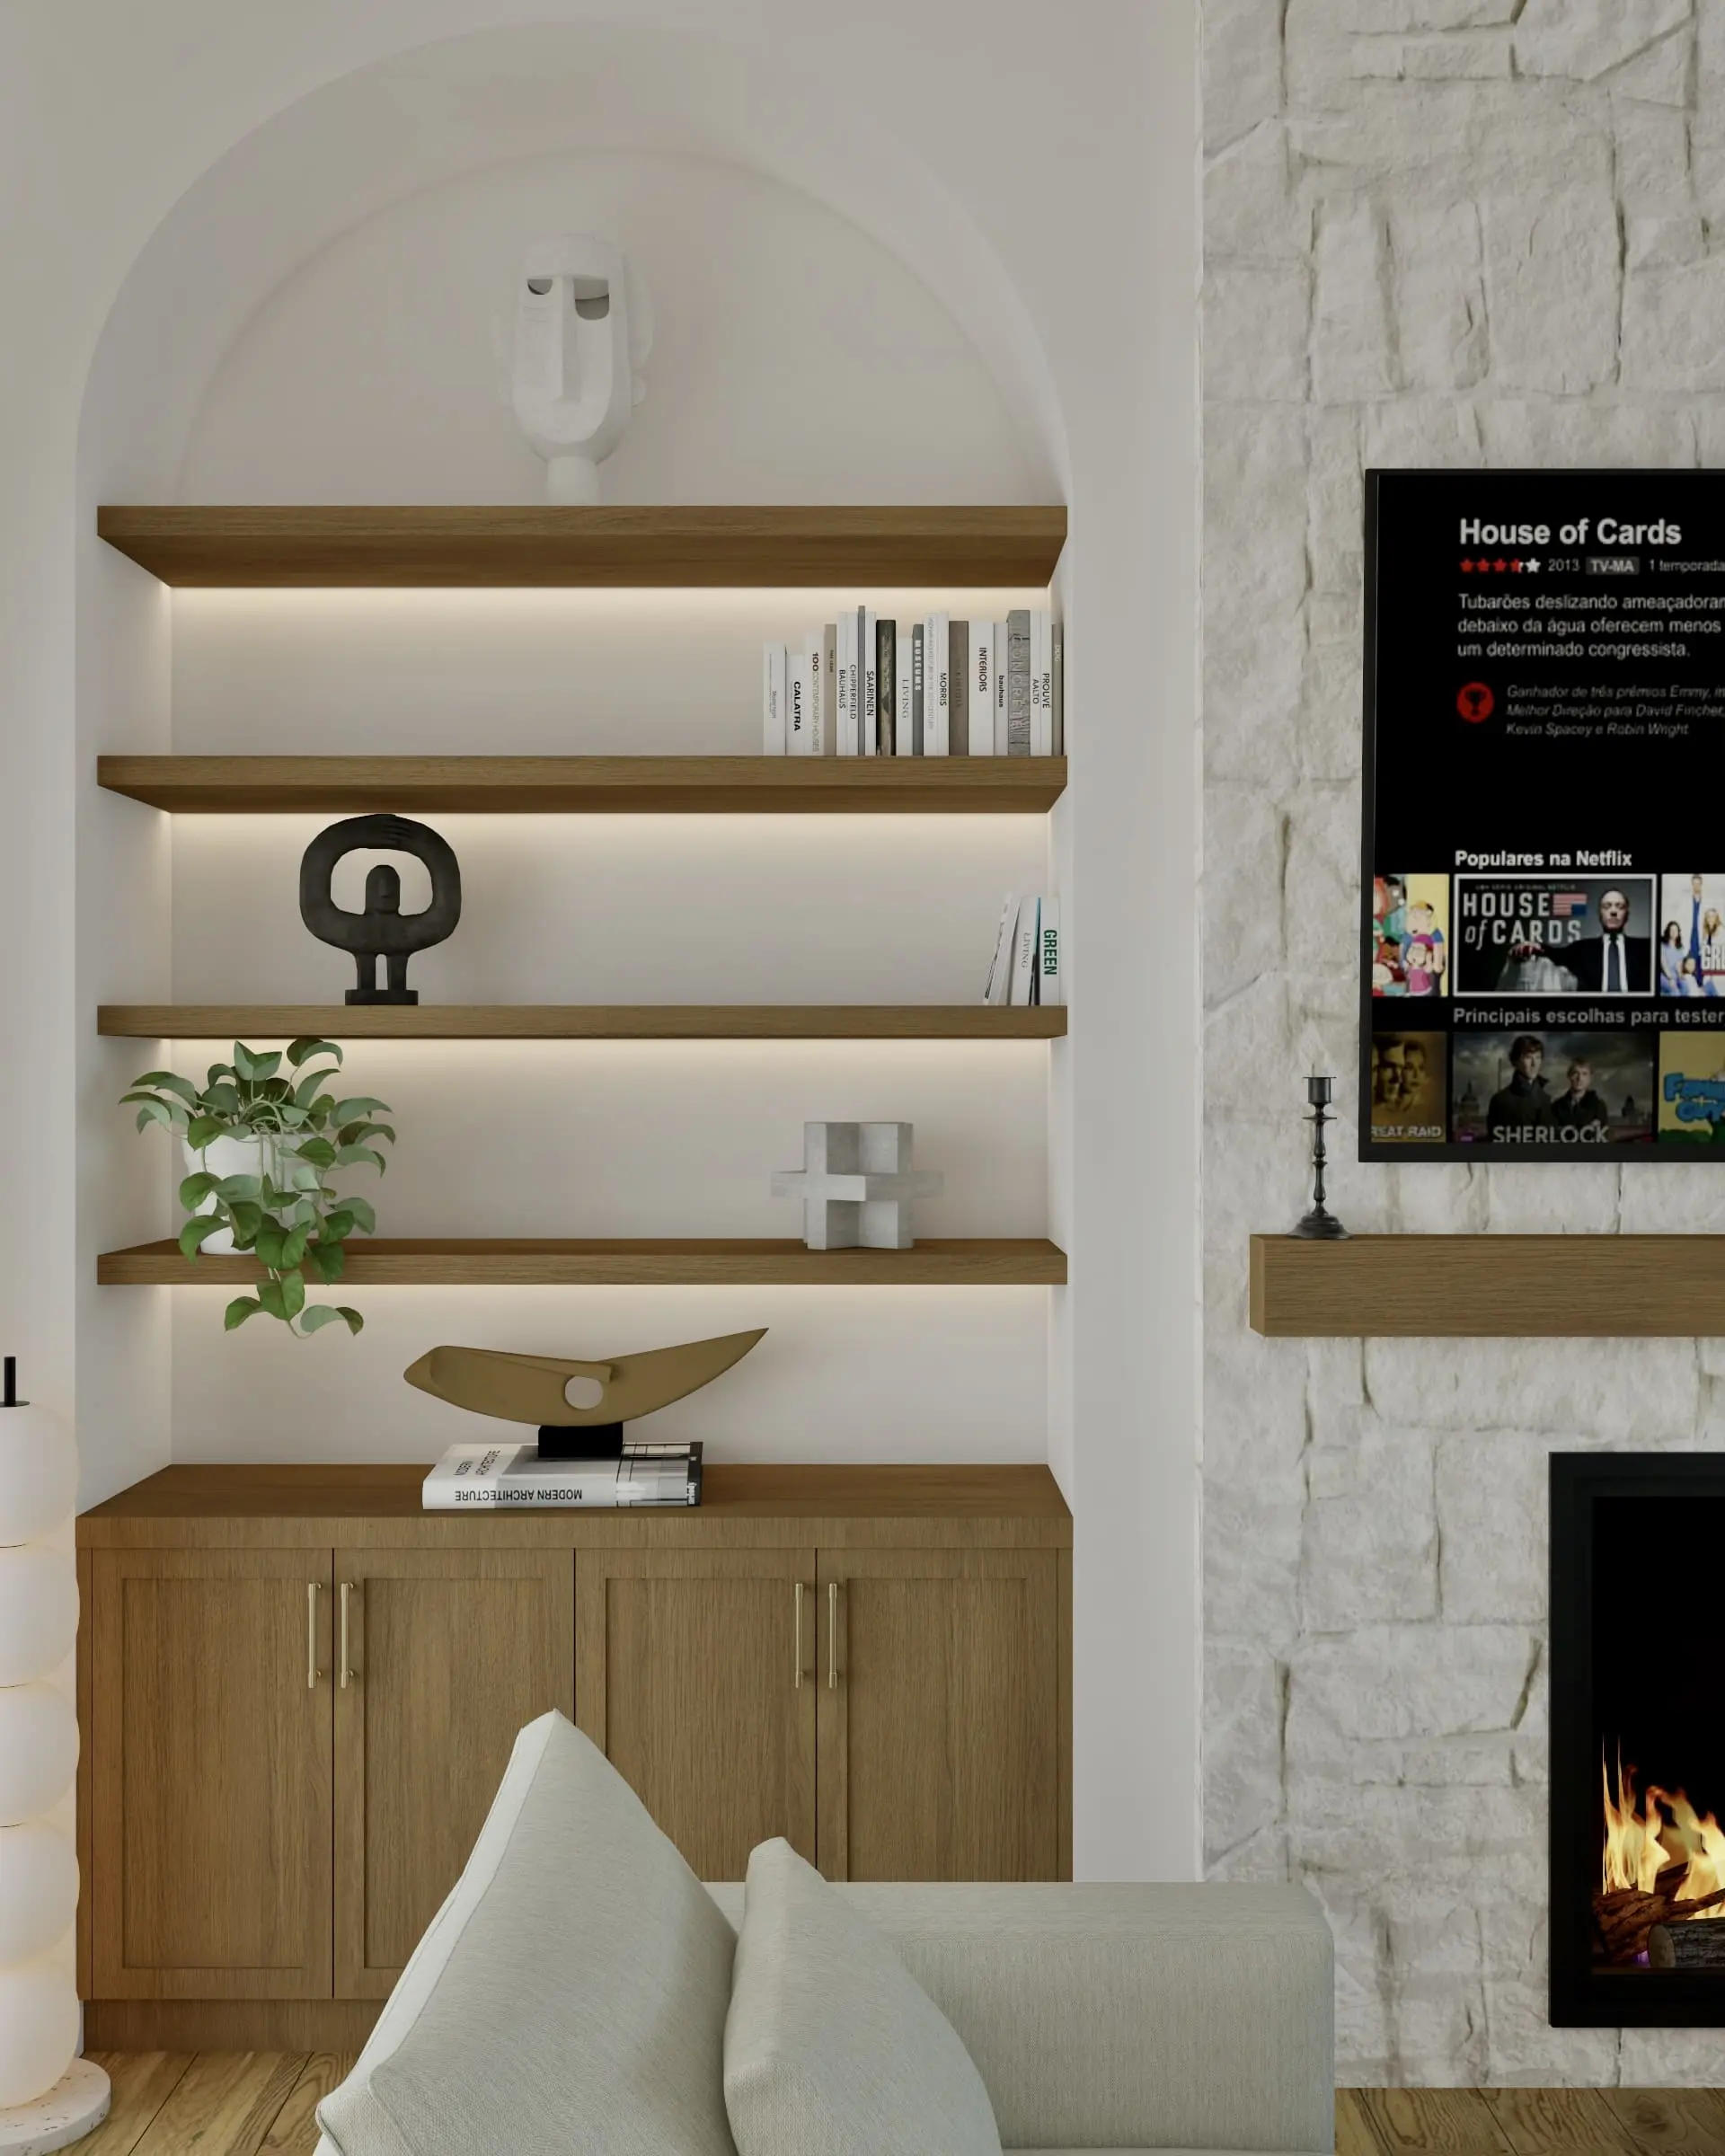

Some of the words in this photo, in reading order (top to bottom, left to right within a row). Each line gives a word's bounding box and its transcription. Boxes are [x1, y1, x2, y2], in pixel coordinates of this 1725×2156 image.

[1460, 518, 1551, 544] House
[1560, 518, 1589, 544] of
[1597, 518, 1682, 544] Cards
[1548, 559, 1580, 571] 2013
[1590, 561, 1635, 572] TV-MA
[1650, 559, 1656, 571] 1
[1659, 559, 1725, 573] temporada
[1458, 594, 1531, 609] Tubarões
[1535, 594, 1618, 609] deslizando
[1458, 617, 1518, 633] debaixo
[1523, 617, 1543, 633] da
[1547, 617, 1586, 637] água
[1590, 617, 1664, 633] oferecem
[1669, 621, 1721, 633] menos
[1457, 644, 1482, 657] um
[1486, 641, 1584, 657] determinado
[1588, 641, 1690, 660] congressista.
[979, 647, 987, 692] INTERIORS
[1571, 685, 1588, 698] de
[793, 681, 801, 731] CALATRA
[1604, 707, 1632, 720] para
[1635, 704, 1674, 717] David
[1507, 723, 1543, 735] Kevin
[1545, 723, 1592, 738] Spacey
[1596, 726, 1604, 735] e
[1607, 723, 1645, 735] Robin
[1649, 723, 1689, 738] Wright
[1455, 850, 1544, 869] Populares
[1549, 853, 1570, 866] na
[1576, 850, 1632, 866] Netflix
[1463, 893, 1550, 916] HOUSE
[1464, 919, 1488, 950] of
[1491, 920, 1581, 945] CARDS
[1022, 932, 1032, 968] LIVING
[1044, 929, 1057, 976] GREEN
[1454, 1007, 1541, 1026] Principais
[1545, 1007, 1625, 1024] escolhas
[1631, 1011, 1669, 1026] para
[1407, 1125, 1442, 1137] RAID
[1492, 1124, 1610, 1143] SHERLOCK
[455, 1489, 535, 1501] ARCHITECTURE
[537, 1489, 583, 1500] MODERN
